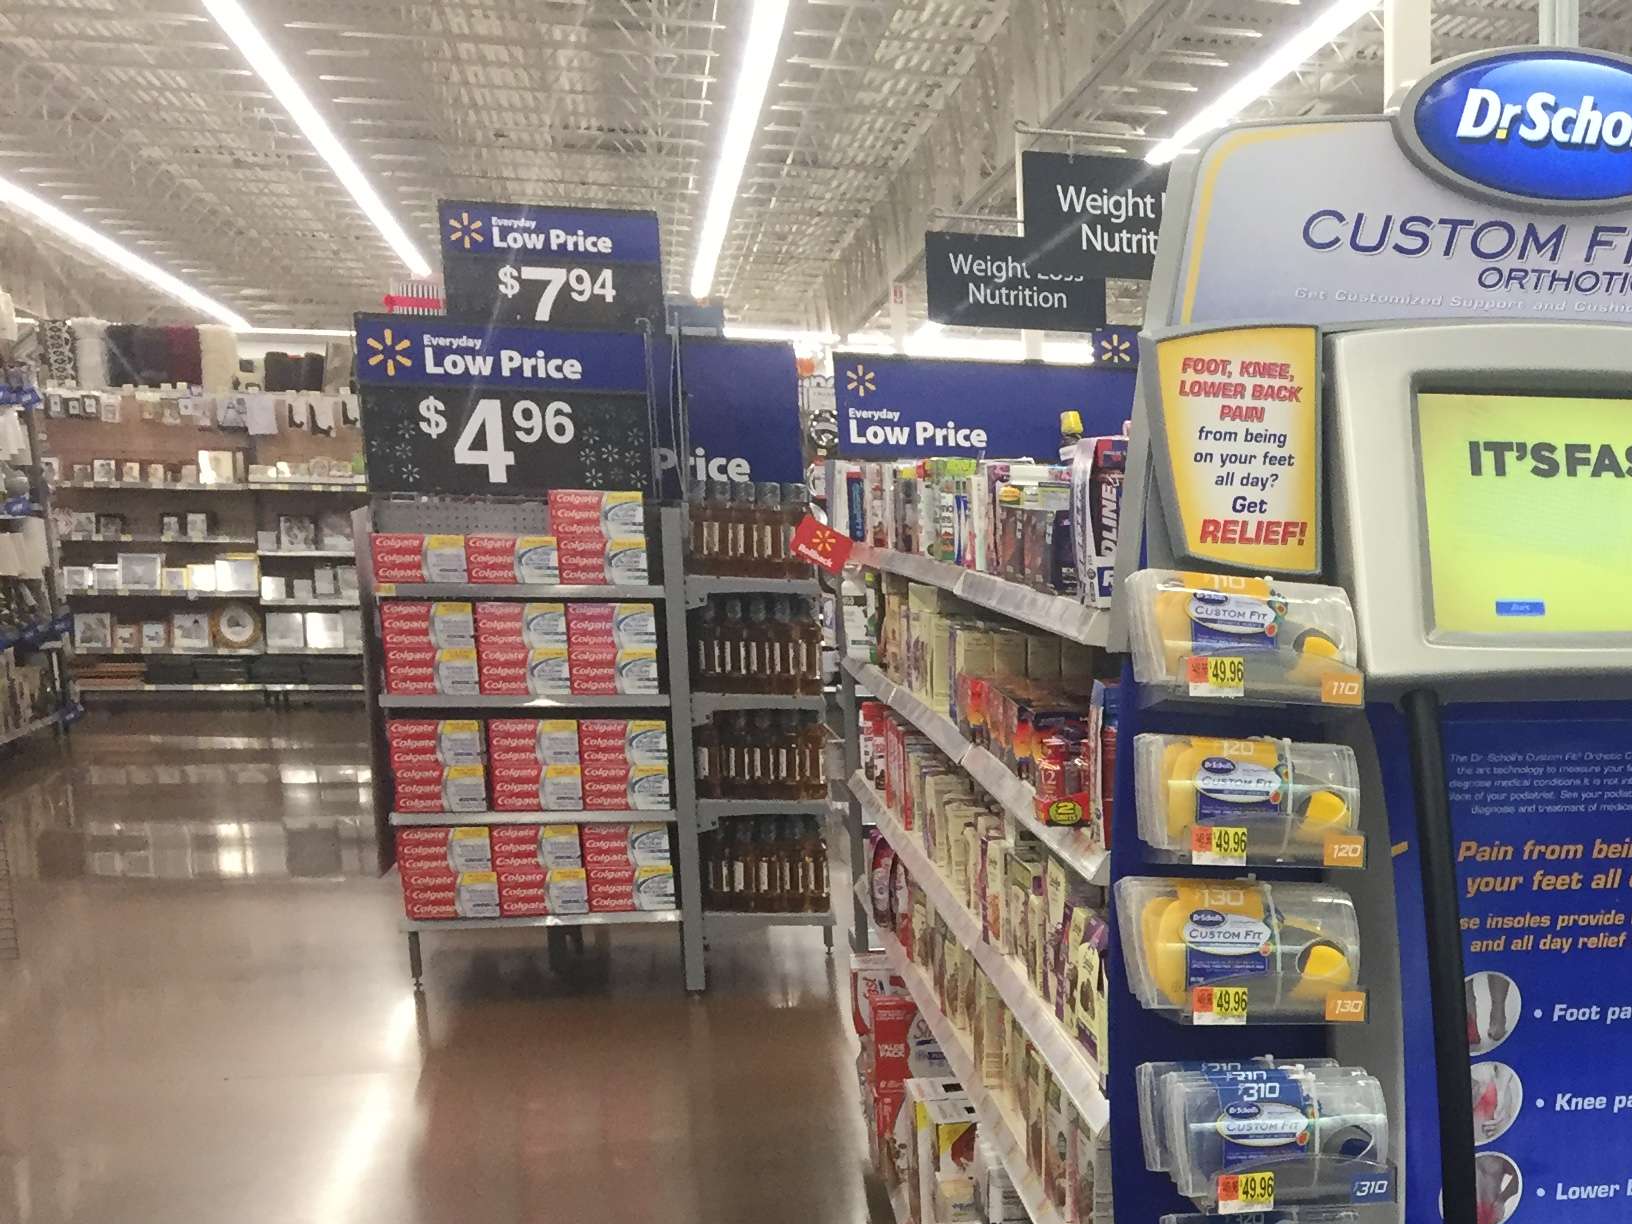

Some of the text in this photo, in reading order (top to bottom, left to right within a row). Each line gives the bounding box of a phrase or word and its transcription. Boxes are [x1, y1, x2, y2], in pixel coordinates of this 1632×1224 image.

[1056, 184, 1155, 223] Weight
[492, 217, 536, 229] Everyday
[492, 228, 612, 253] Low Price
[1081, 224, 1158, 255] Nutrit
[1302, 209, 1569, 262] CUSTOM
[949, 253, 1031, 281] Weight
[968, 284, 1067, 309] Nutrition
[423, 334, 482, 351] Everyday
[424, 349, 583, 380] Low Price
[1181, 358, 1295, 382] FOOT, KNEE,
[1179, 381, 1303, 402] LOWER BACK
[848, 408, 900, 421] Everyday
[1220, 405, 1265, 423] PAIN
[849, 420, 987, 448] Low Price
[1199, 427, 1287, 448] from being
[652, 447, 751, 482] Price
[1194, 451, 1295, 467] on your feet
[1468, 440, 1560, 478] IT'S
[1215, 472, 1279, 491] all day?
[556, 493, 599, 505] Colgate
[1232, 496, 1268, 514] Get
[1200, 519, 1308, 546] RELIEF!
[376, 537, 419, 550] Colgate
[469, 537, 512, 550] Colgate
[379, 568, 422, 580] Colgate
[1195, 605, 1268, 621] CUSTOM FIT
[1333, 844, 1361, 858] 120
[1458, 839, 1514, 862] Pain
[1523, 839, 1583, 860] from
[1466, 875, 1523, 898] your
[1532, 870, 1582, 891] feet
[1591, 868, 1621, 889] all
[1486, 912, 1551, 929] insoles
[1556, 910, 1624, 931] provide
[1189, 929, 1263, 940] CUSTOM FIT
[1470, 936, 1506, 953] and
[1511, 934, 1533, 951] all
[1539, 934, 1573, 953] day
[1578, 932, 1627, 950] relief
[1335, 999, 1362, 1013] 130
[1552, 1003, 1601, 1022] Foot
[1555, 1093, 1607, 1112] Knee
[1555, 1180, 1620, 1201] Lower
